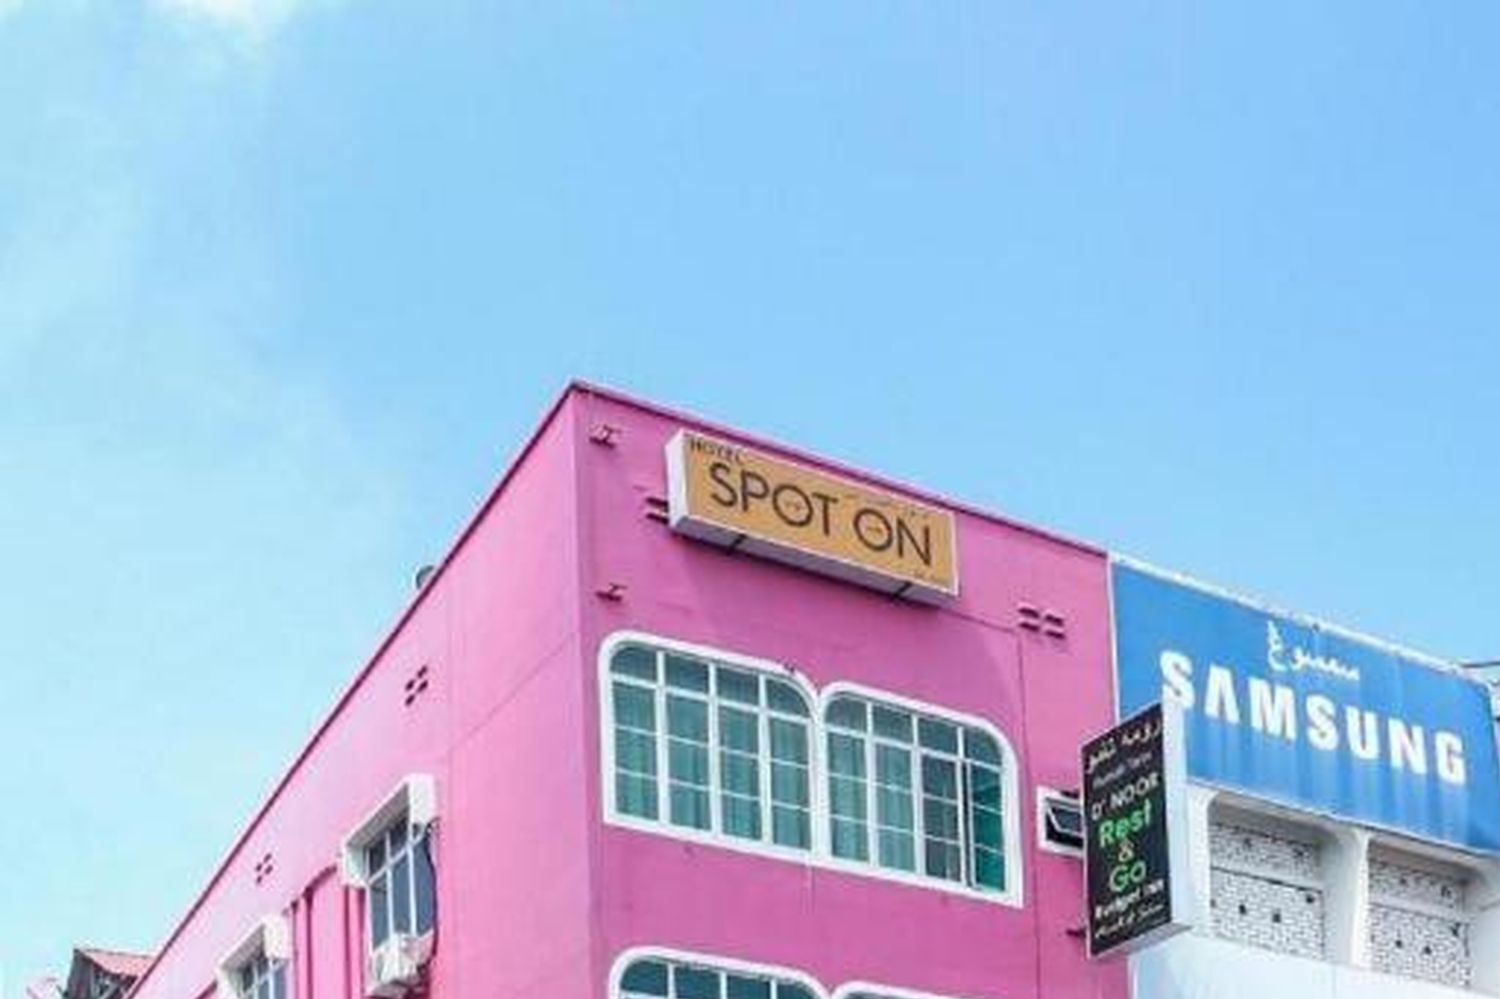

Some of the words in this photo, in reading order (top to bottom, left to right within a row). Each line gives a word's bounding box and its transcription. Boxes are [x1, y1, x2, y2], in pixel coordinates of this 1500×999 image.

[709, 462, 838, 536] SPOT
[853, 508, 932, 567] ON
[1159, 650, 1467, 785] SAMSUNG
[1100, 798, 1151, 848] Rest
